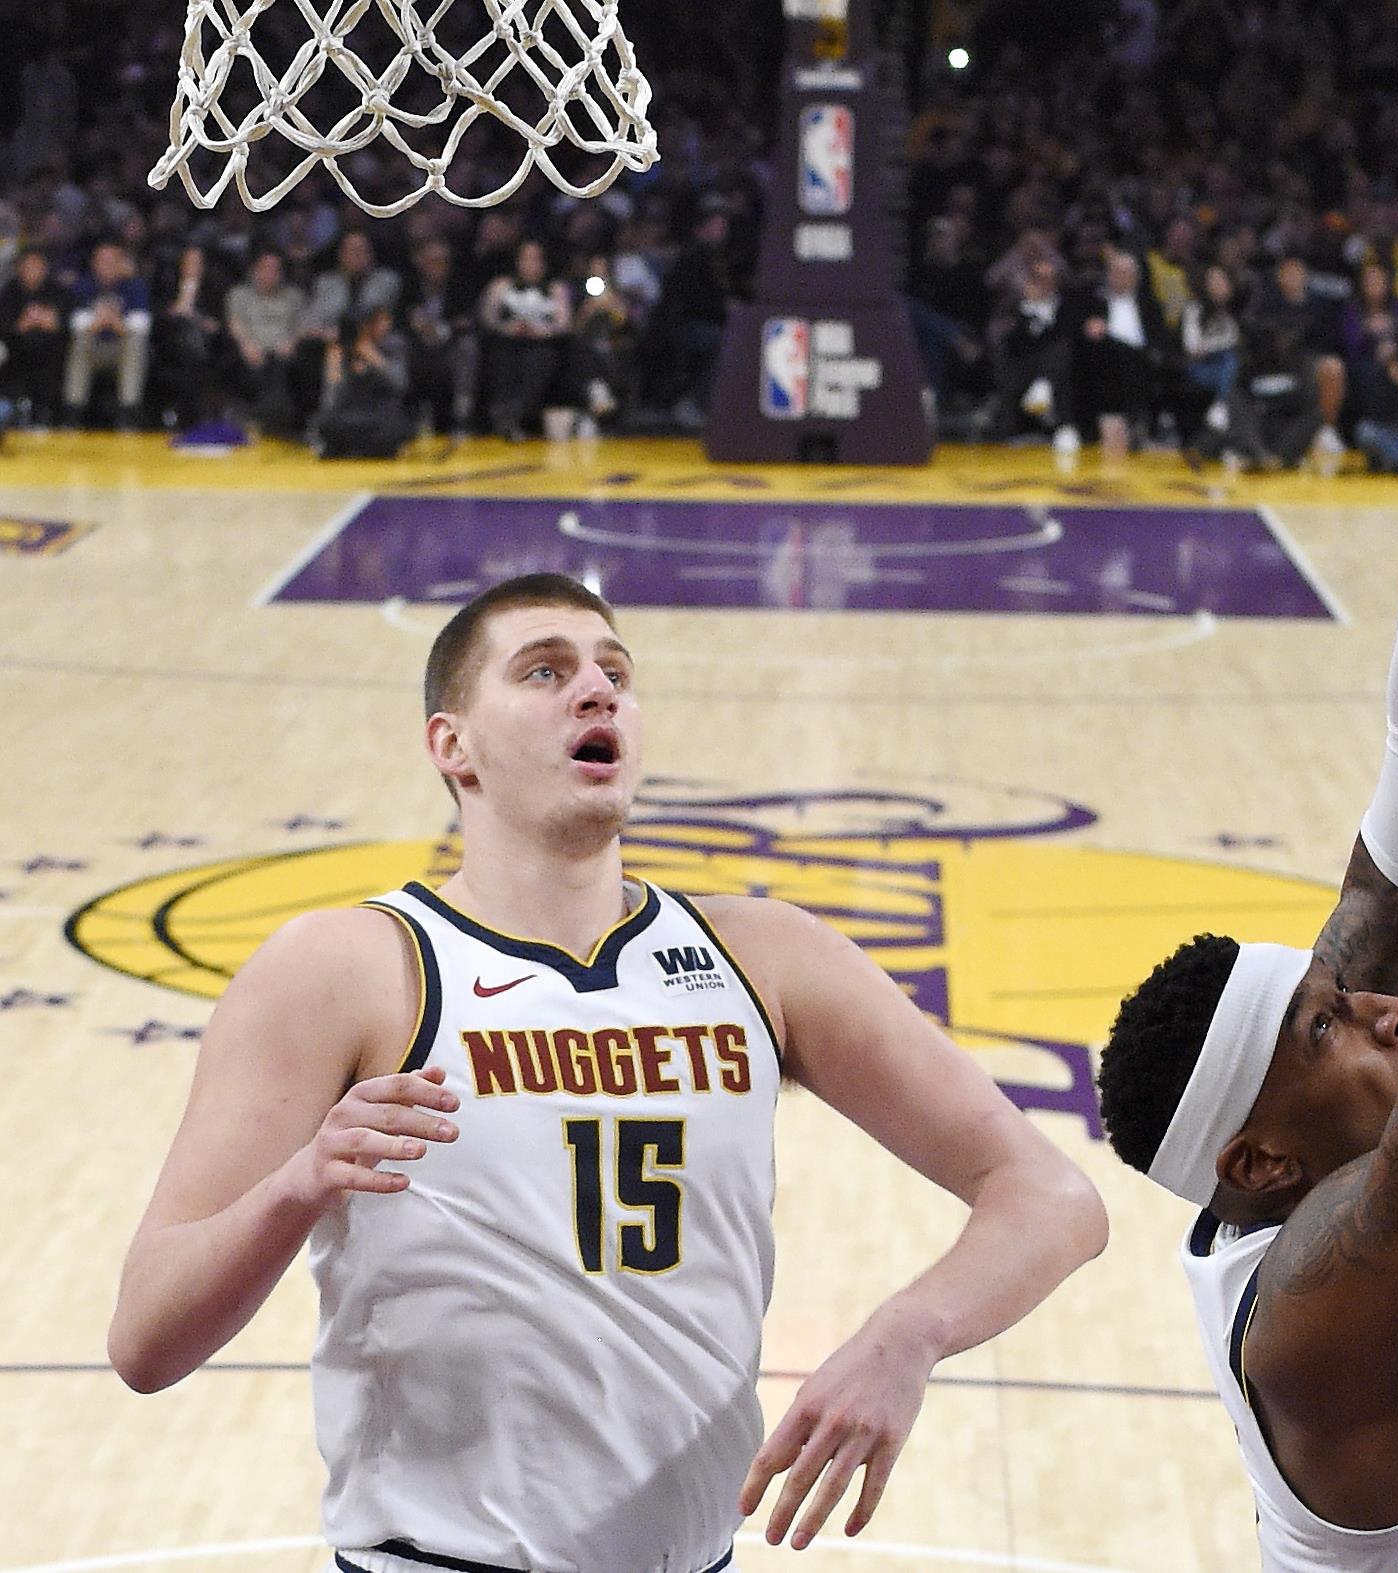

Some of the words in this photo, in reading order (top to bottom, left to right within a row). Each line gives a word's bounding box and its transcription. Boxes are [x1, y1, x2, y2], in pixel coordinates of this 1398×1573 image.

[652, 946, 715, 975] WU
[663, 973, 722, 987] WESTERN
[685, 978, 726, 991] UNION
[459, 1023, 753, 1099] NUGGETS
[561, 1115, 689, 1277] 15
